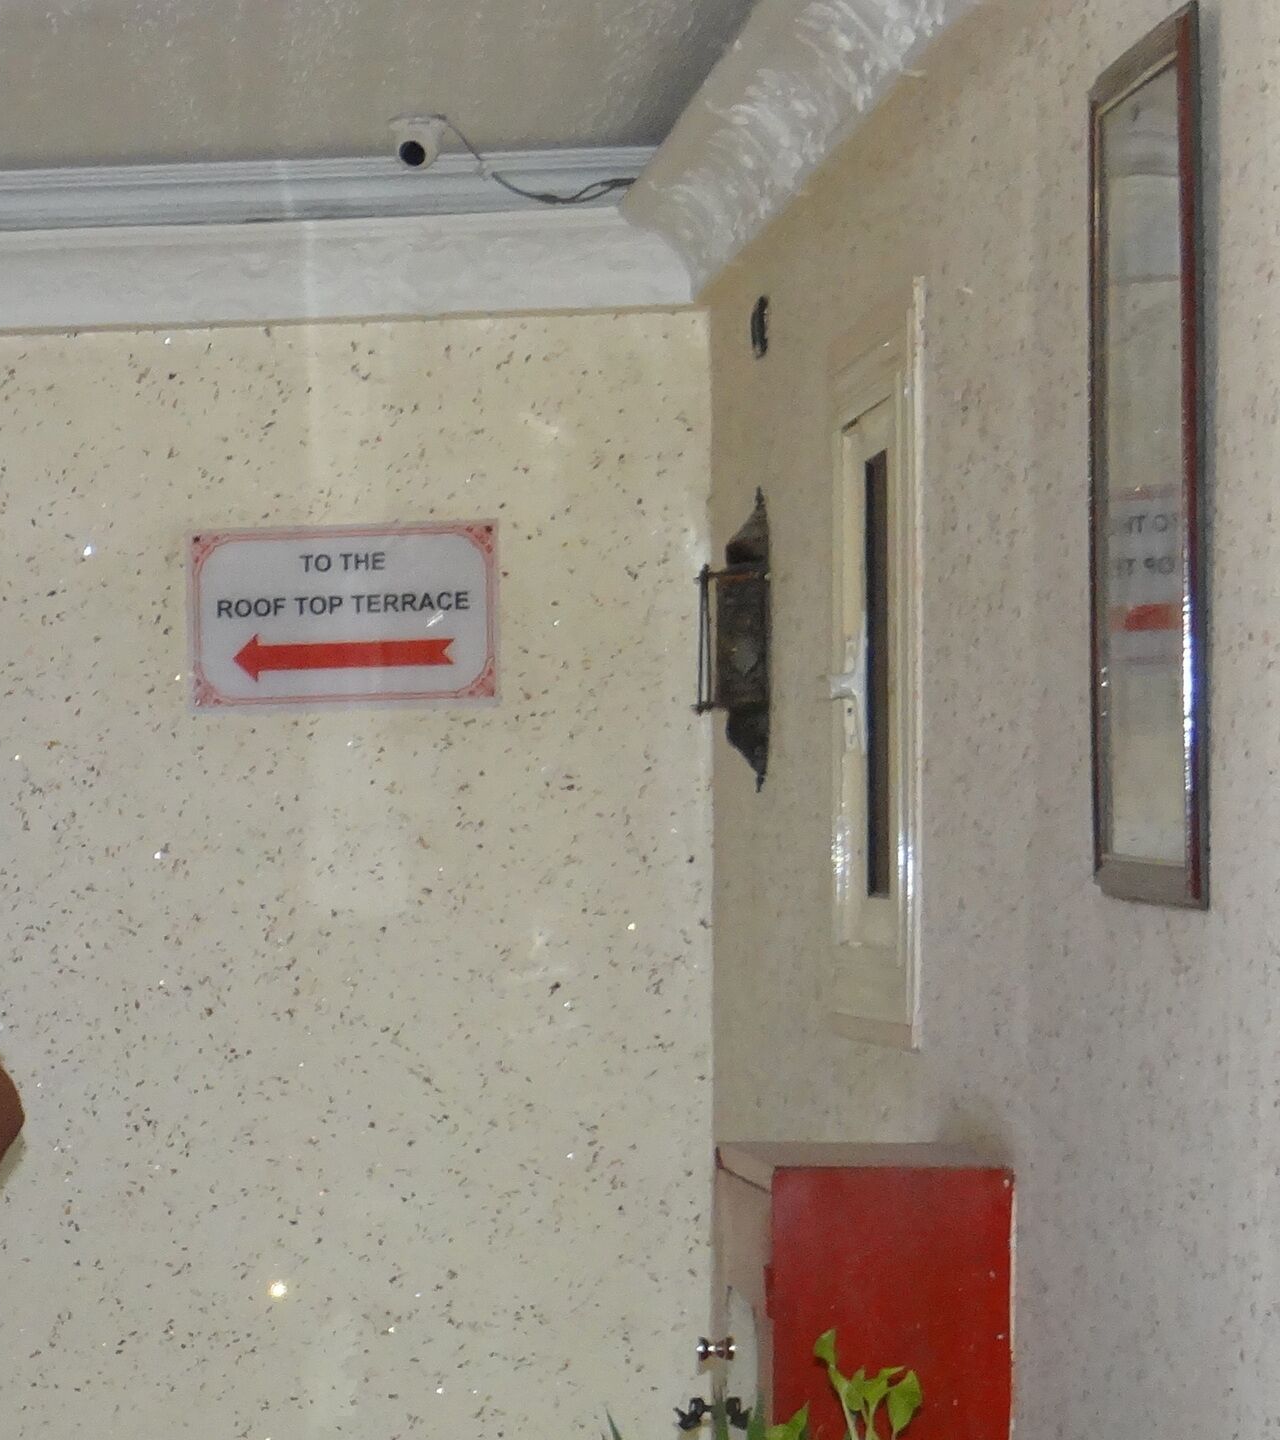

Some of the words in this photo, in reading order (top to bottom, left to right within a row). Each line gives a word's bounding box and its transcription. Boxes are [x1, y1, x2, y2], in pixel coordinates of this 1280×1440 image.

[299, 554, 332, 573] TO
[340, 552, 386, 572] THE
[216, 598, 286, 619] ROOF
[293, 596, 343, 616] TOP
[351, 591, 470, 613] TERRACE
